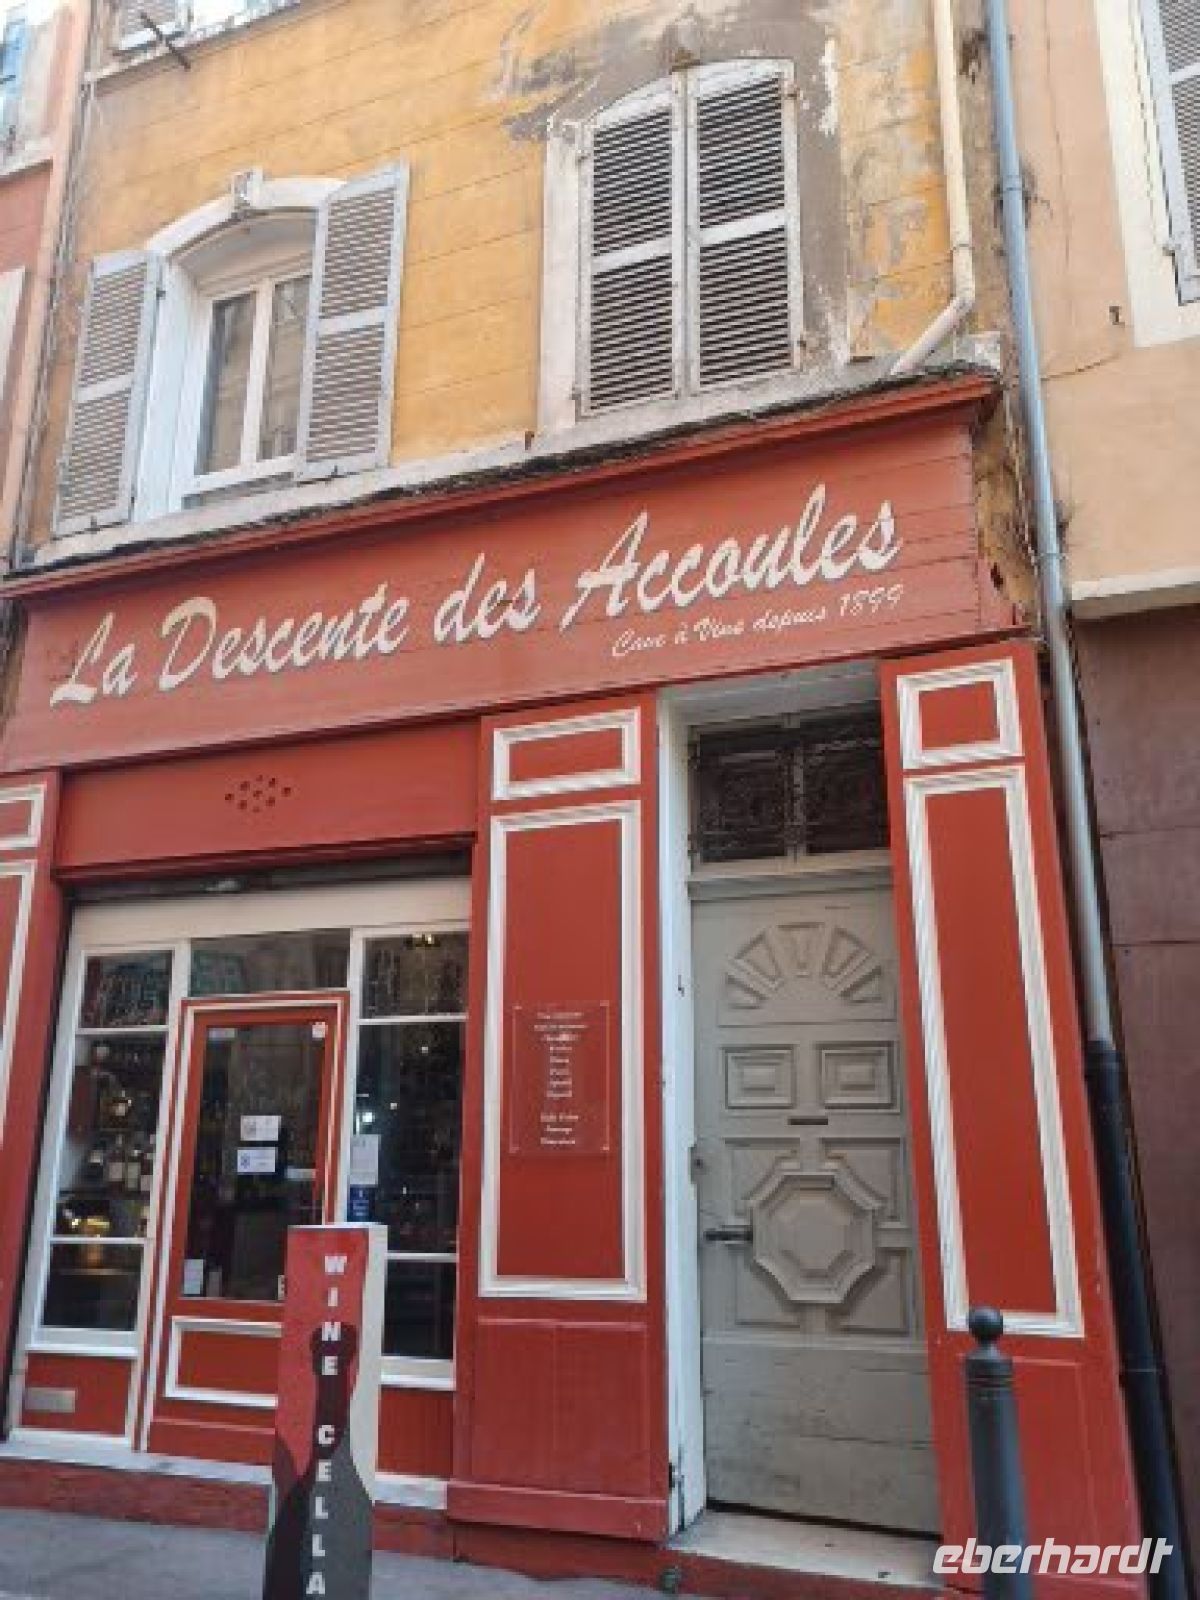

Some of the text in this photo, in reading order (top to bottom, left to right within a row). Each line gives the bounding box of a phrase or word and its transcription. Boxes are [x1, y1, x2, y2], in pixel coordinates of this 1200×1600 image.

[49, 483, 904, 708] La Descente des Accoules
[611, 628, 667, 657] Cave
[320, 1255, 348, 1376] WINE
